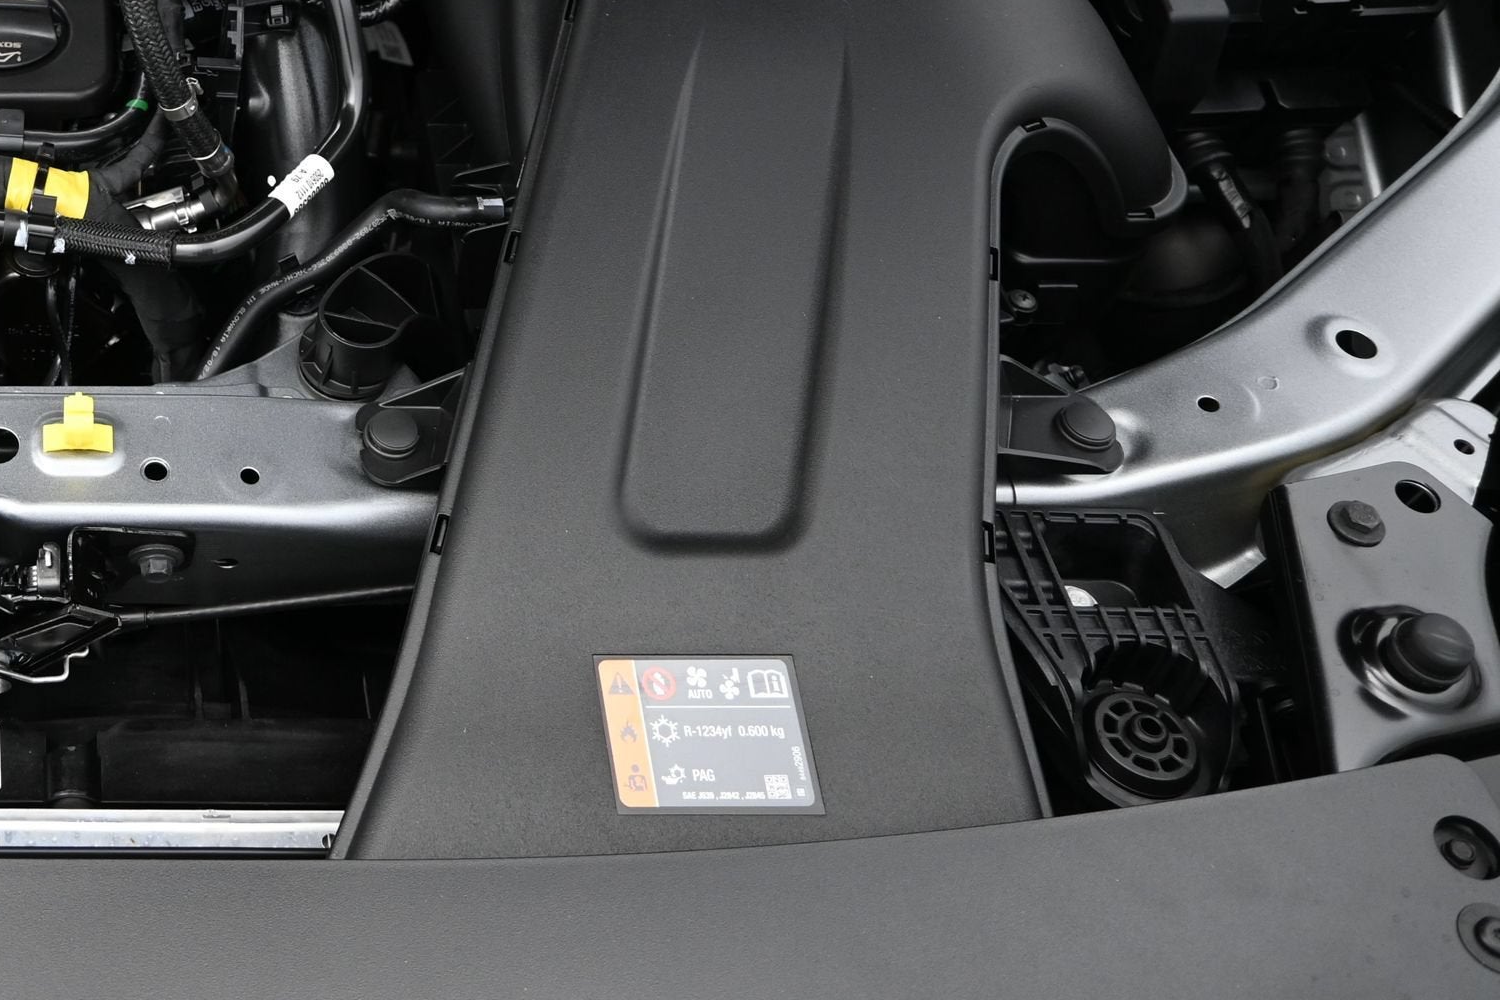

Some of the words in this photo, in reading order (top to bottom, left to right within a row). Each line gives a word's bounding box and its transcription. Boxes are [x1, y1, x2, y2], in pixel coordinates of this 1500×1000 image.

[688, 690, 713, 699] AUTO
[684, 725, 732, 739] R-1234yf
[738, 725, 768, 737] 0.600
[771, 725, 785, 739] kg
[692, 769, 715, 782] PAG
